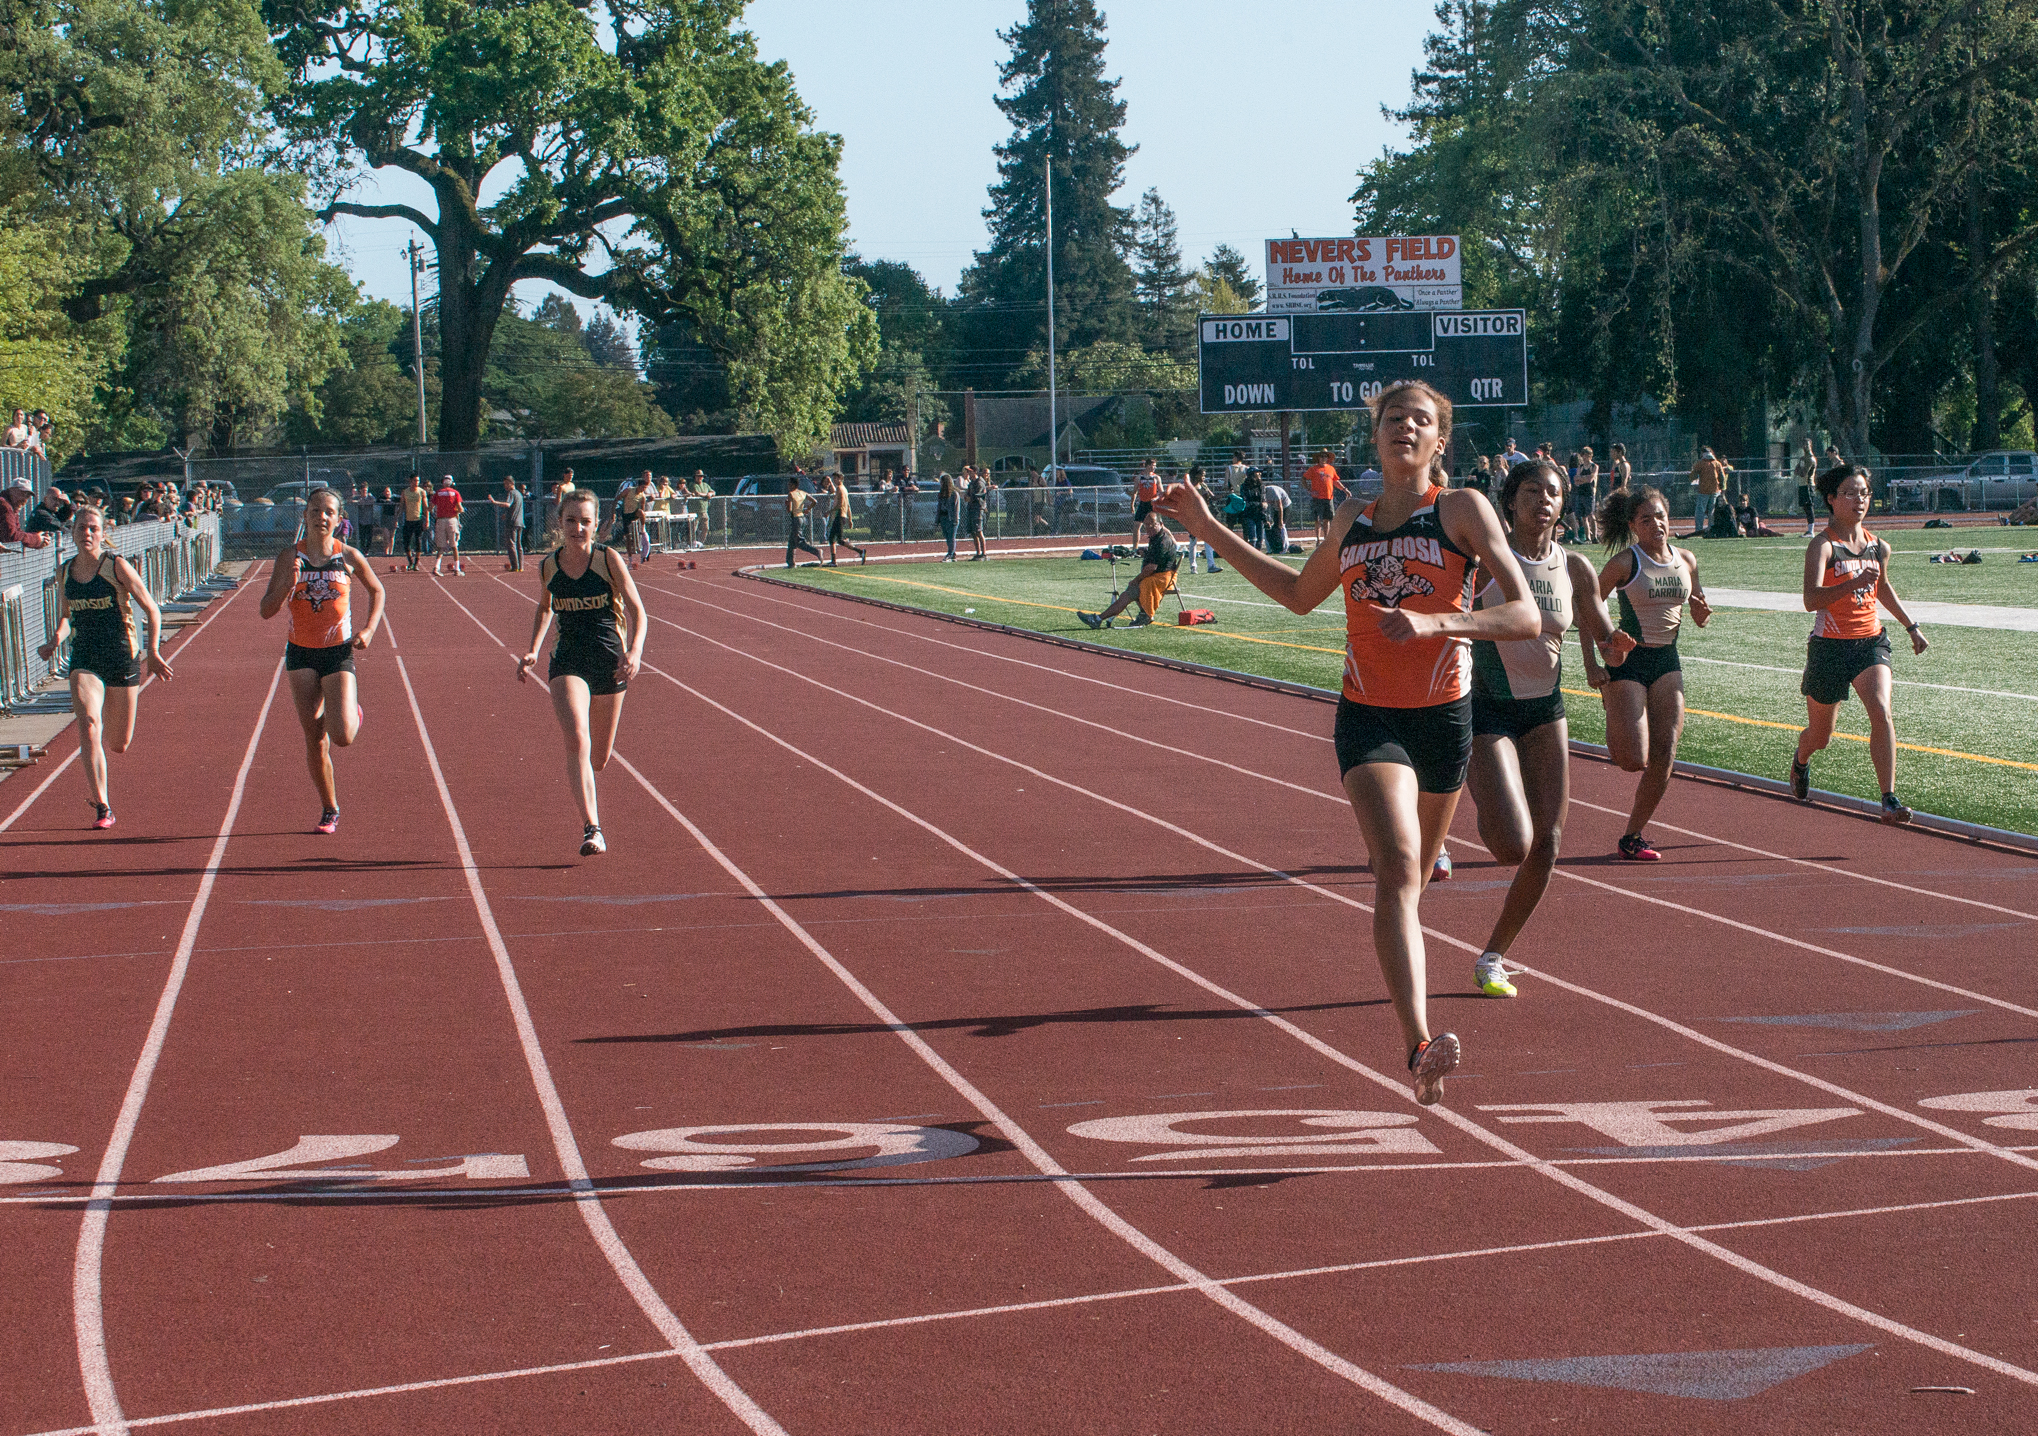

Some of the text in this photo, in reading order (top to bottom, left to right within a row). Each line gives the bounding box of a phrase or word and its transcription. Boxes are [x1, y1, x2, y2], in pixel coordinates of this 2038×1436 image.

[1270, 237, 1455, 264] NEVERS FIELD
[1283, 264, 1446, 285] Home Of The Panthers
[1215, 322, 1277, 339] HOME
[1439, 316, 1519, 334] VISITOR
[1291, 358, 1315, 369] TOL
[1412, 355, 1435, 366] TOL
[1224, 384, 1275, 405] DOWN
[1330, 381, 1382, 402] TO GO
[1470, 378, 1503, 401] QTR
[1339, 536, 1445, 575] SANTA ROSA
[322, 570, 347, 584] ROSA
[1655, 576, 1683, 586] MARIA
[1529, 579, 1554, 595] ARIA
[1649, 588, 1688, 599] CARRILLO
[554, 593, 609, 611] WINDSOR
[1473, 1100, 1864, 1147] 4
[1066, 1109, 1443, 1162] 5
[149, 1134, 530, 1183] 7
